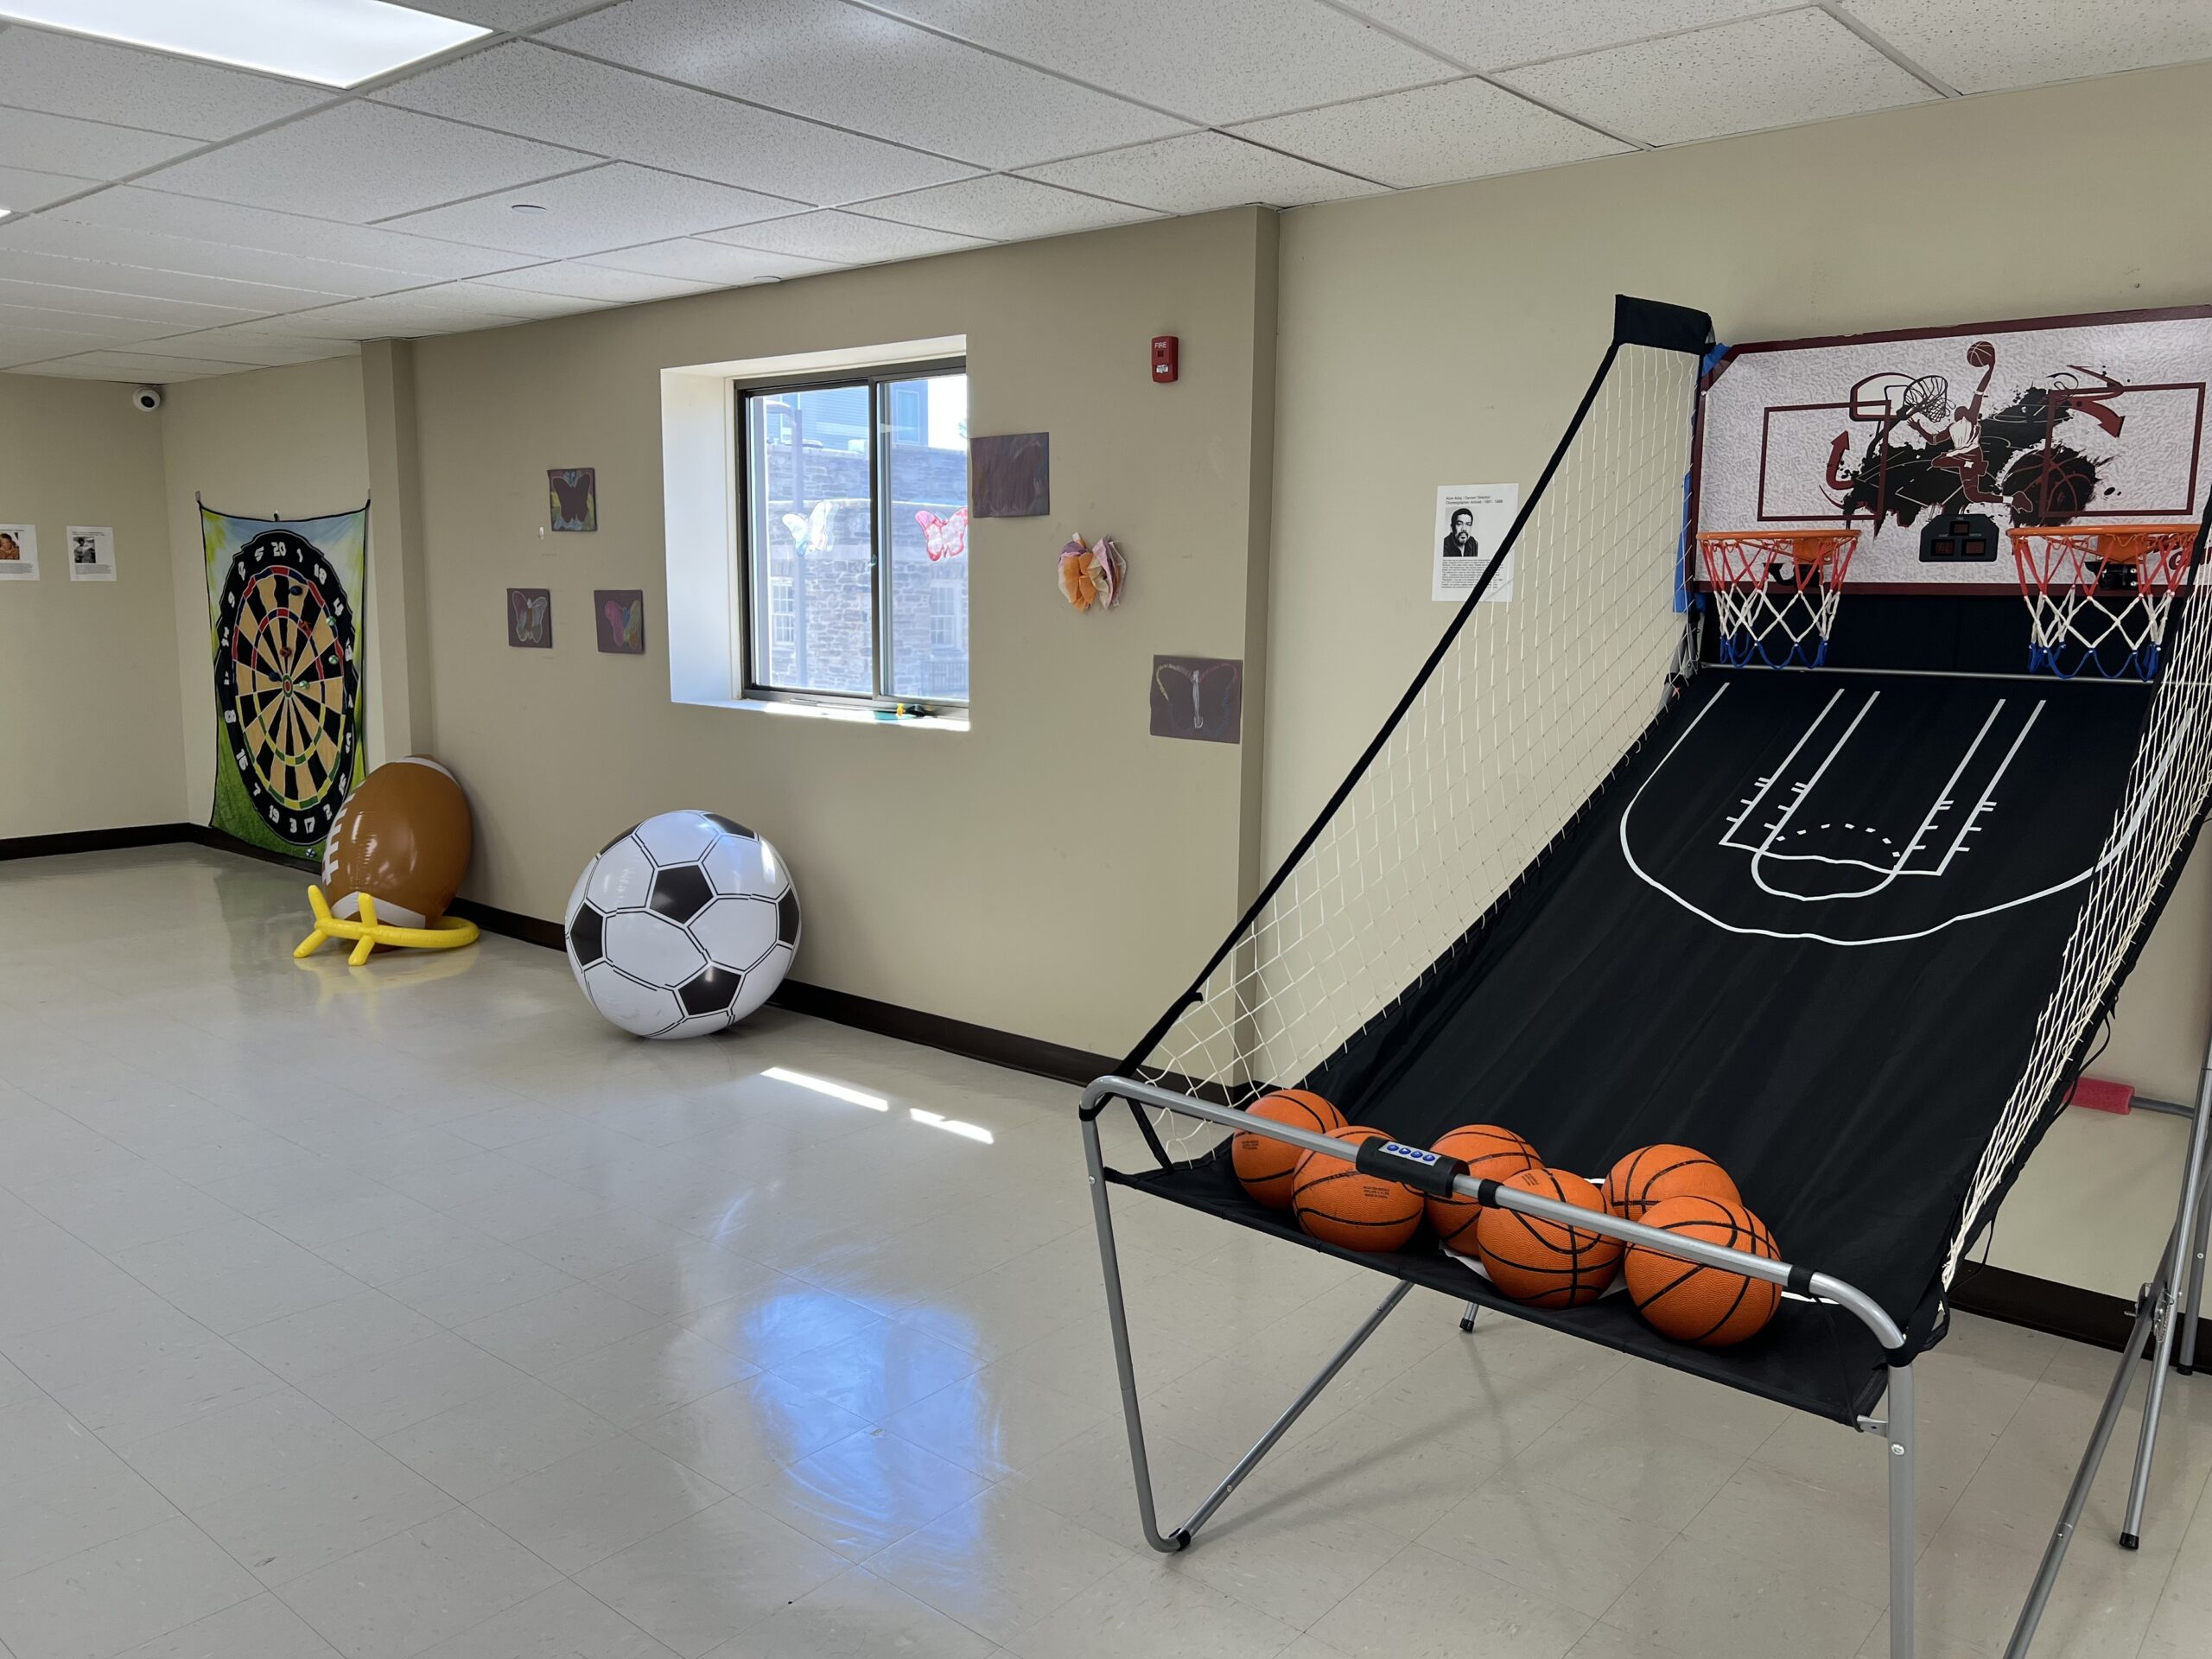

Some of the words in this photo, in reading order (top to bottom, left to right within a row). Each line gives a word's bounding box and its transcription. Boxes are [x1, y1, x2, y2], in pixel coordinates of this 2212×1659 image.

[254, 546, 264, 562] 5
[270, 541, 287, 556] 20
[296, 548, 303, 563] 1
[314, 563, 327, 585] 18
[269, 804, 280, 823] 19
[323, 804, 333, 821] 2
[289, 817, 297, 833] 3
[304, 816, 315, 834] 17
